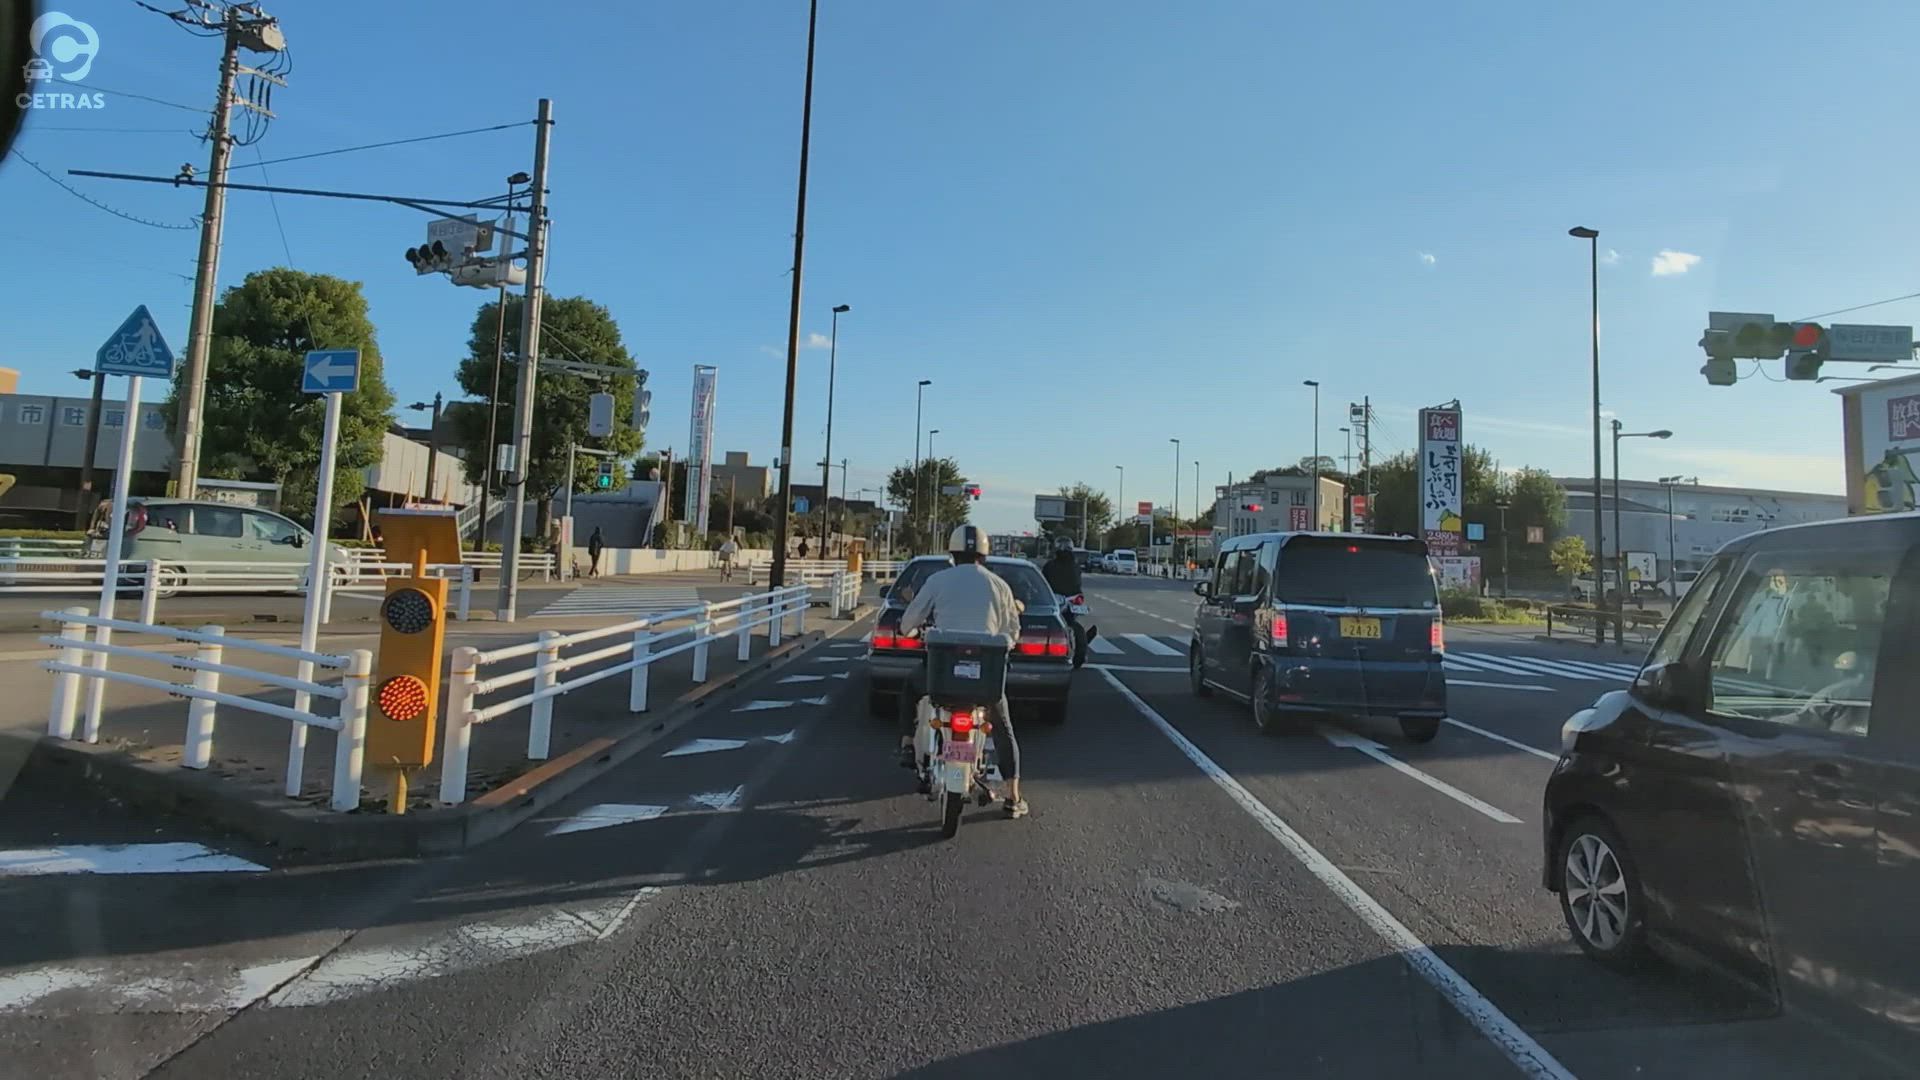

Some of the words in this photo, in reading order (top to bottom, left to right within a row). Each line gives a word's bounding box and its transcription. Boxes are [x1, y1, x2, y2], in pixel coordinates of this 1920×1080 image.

[1430, 412, 1453, 426] 食べ
[1432, 424, 1456, 440] 放題
[1441, 444, 1459, 496] 寿司
[1630, 581, 1641, 594] P
